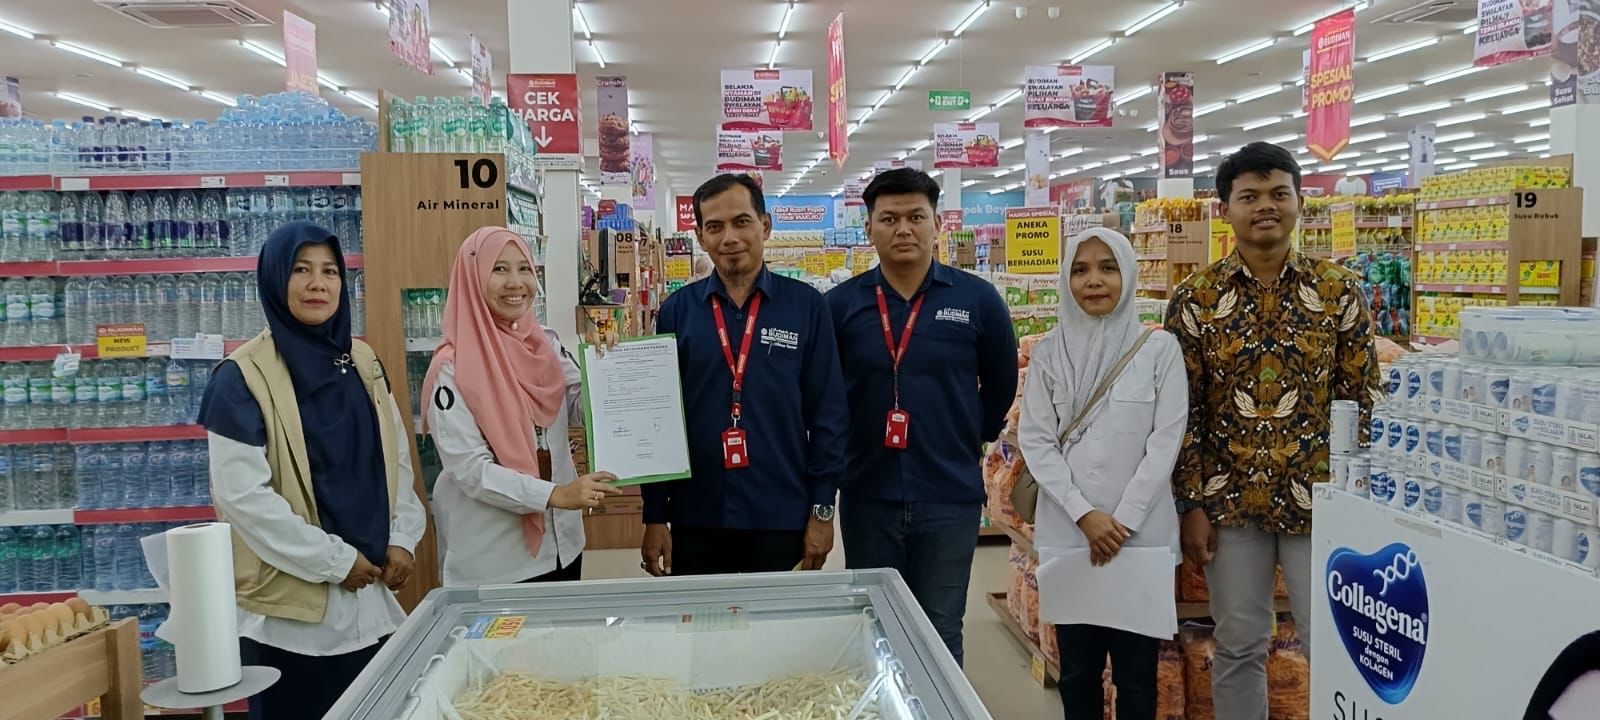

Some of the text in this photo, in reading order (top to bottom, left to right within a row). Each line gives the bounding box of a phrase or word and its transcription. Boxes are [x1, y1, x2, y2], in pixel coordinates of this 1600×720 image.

[1479, 27, 1520, 45] KELUARGA
[1311, 64, 1352, 89] SPESIAL
[1312, 86, 1351, 109] PROMO
[1554, 86, 1573, 96] Susu
[524, 92, 560, 105] CEK
[1554, 95, 1574, 104] Sehat
[514, 108, 576, 122] HARGA
[455, 159, 498, 189] 10
[417, 199, 500, 210] Air Mineral
[1514, 192, 1538, 208] 19
[985, 203, 1008, 216] Bay
[1016, 221, 1048, 229] ANEKA
[1170, 224, 1182, 233] 18
[616, 233, 633, 242] 08
[1016, 231, 1050, 240] PROMO
[1008, 259, 1058, 267] BERHADIAH
[768, 329, 798, 341] BUDIMAN
[1328, 570, 1426, 645] Collagena
[1352, 626, 1403, 662] SUSU STERIL
[1364, 645, 1390, 665] dengan
[1359, 654, 1394, 681] KOLAGEN
